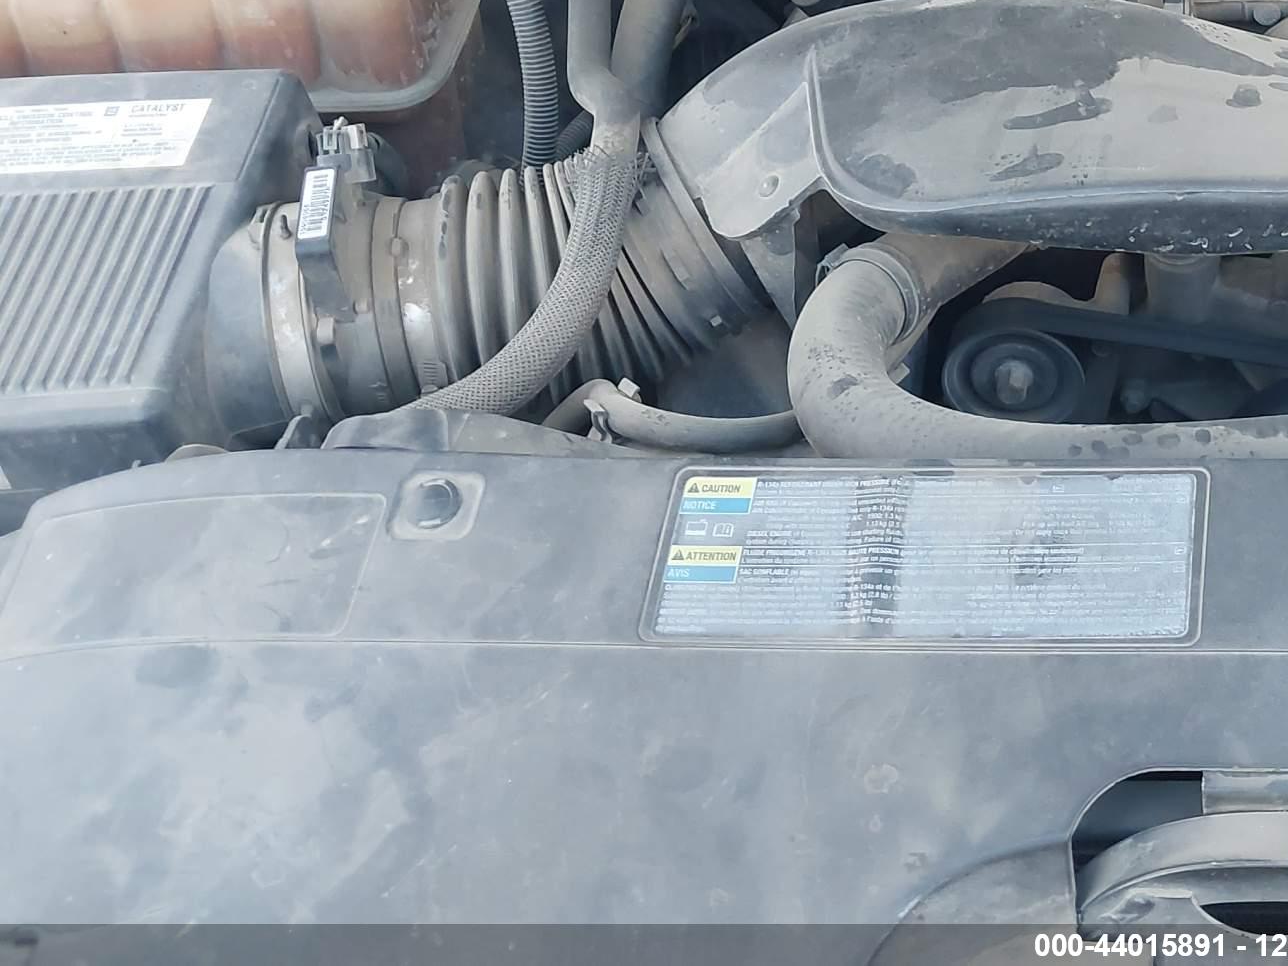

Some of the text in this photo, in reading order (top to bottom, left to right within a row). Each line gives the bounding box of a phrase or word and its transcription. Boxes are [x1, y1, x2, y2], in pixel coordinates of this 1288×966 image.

[131, 103, 186, 113] CATALYST
[701, 483, 741, 494] CAUTION
[682, 500, 717, 510] NOTICE
[685, 551, 737, 561] ATTENTION
[667, 568, 690, 578] AVIS
